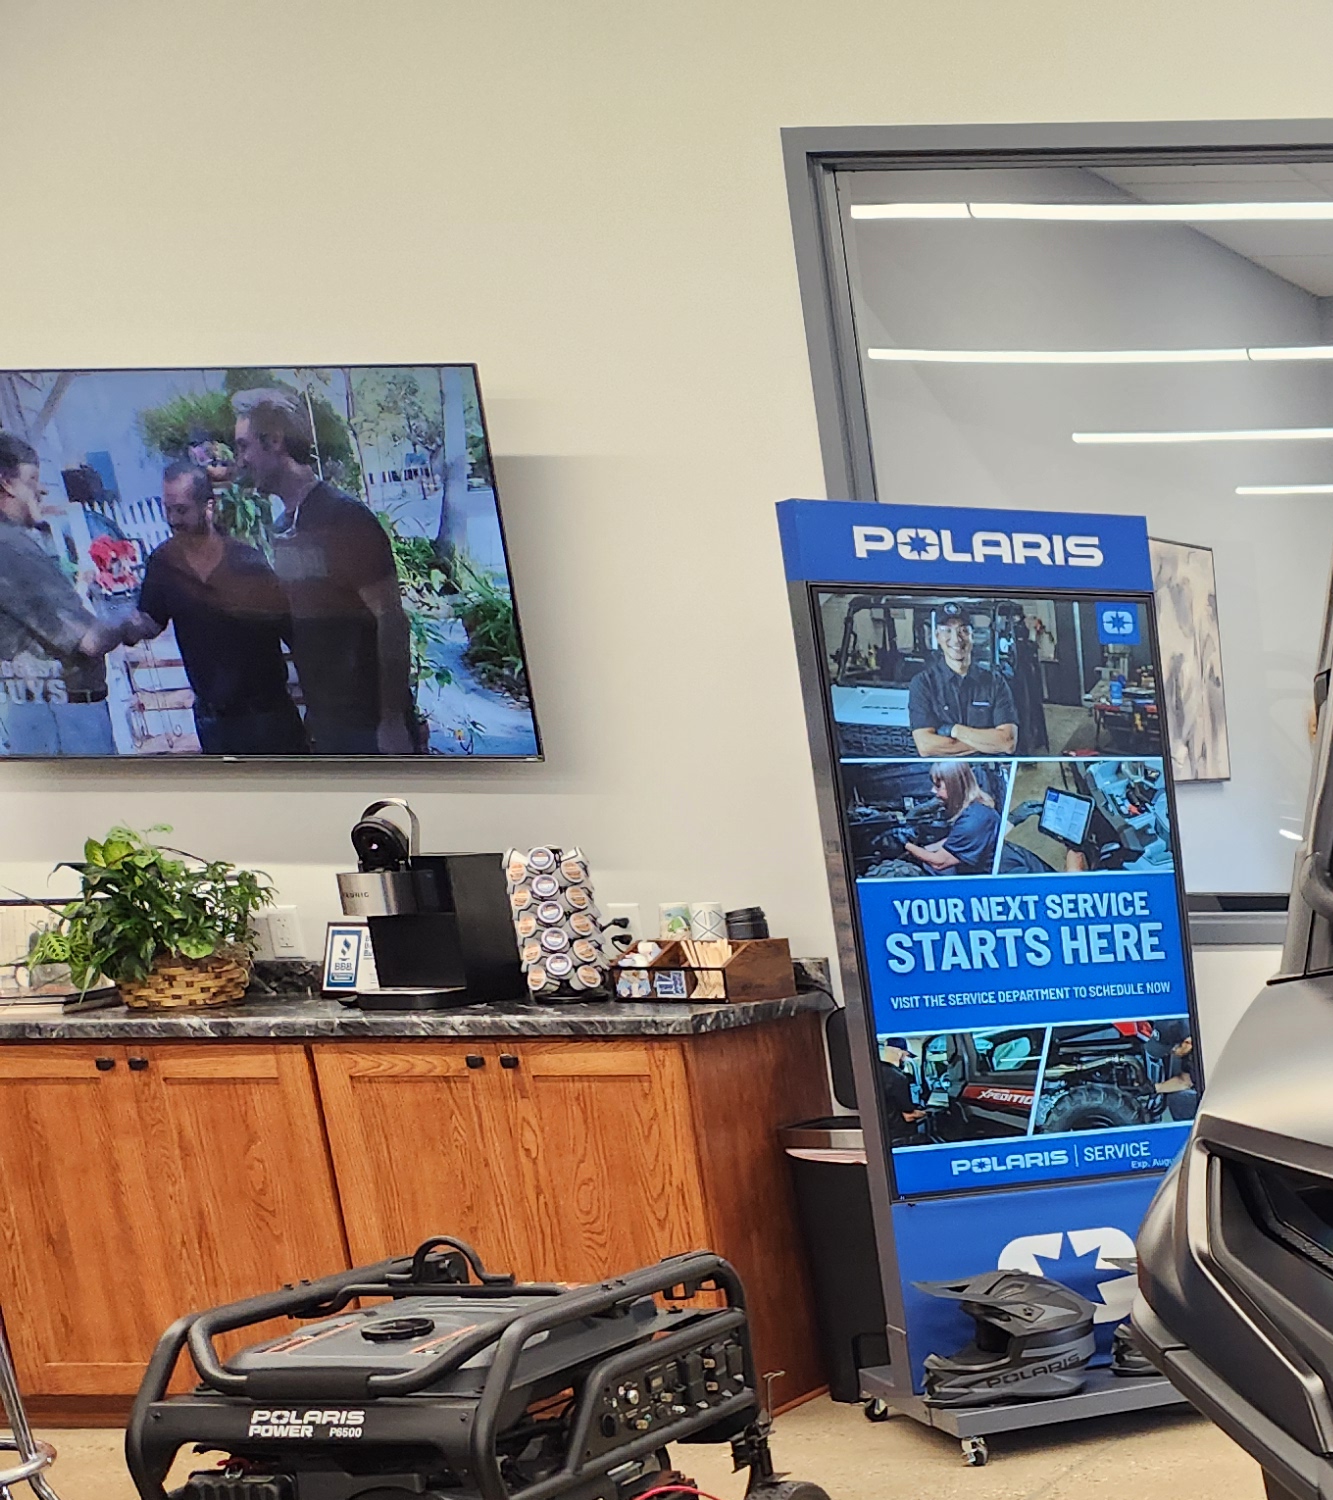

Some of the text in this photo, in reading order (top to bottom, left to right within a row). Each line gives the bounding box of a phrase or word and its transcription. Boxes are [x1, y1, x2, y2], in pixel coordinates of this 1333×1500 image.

[852, 525, 1104, 567] POLARIS
[893, 891, 1150, 925] YOUR NEXT SERVICE
[886, 922, 1166, 973] STARTS HERE
[891, 981, 1171, 1010] VISIT THE SERVICE DEPARTMENT TO SCHEDULE NOW
[951, 1141, 1151, 1176] POLARIS SERVICE
[986, 1353, 1080, 1388] POLARIS
[248, 1425, 363, 1438] POWER P6500
[250, 1410, 366, 1425] POLARIS
